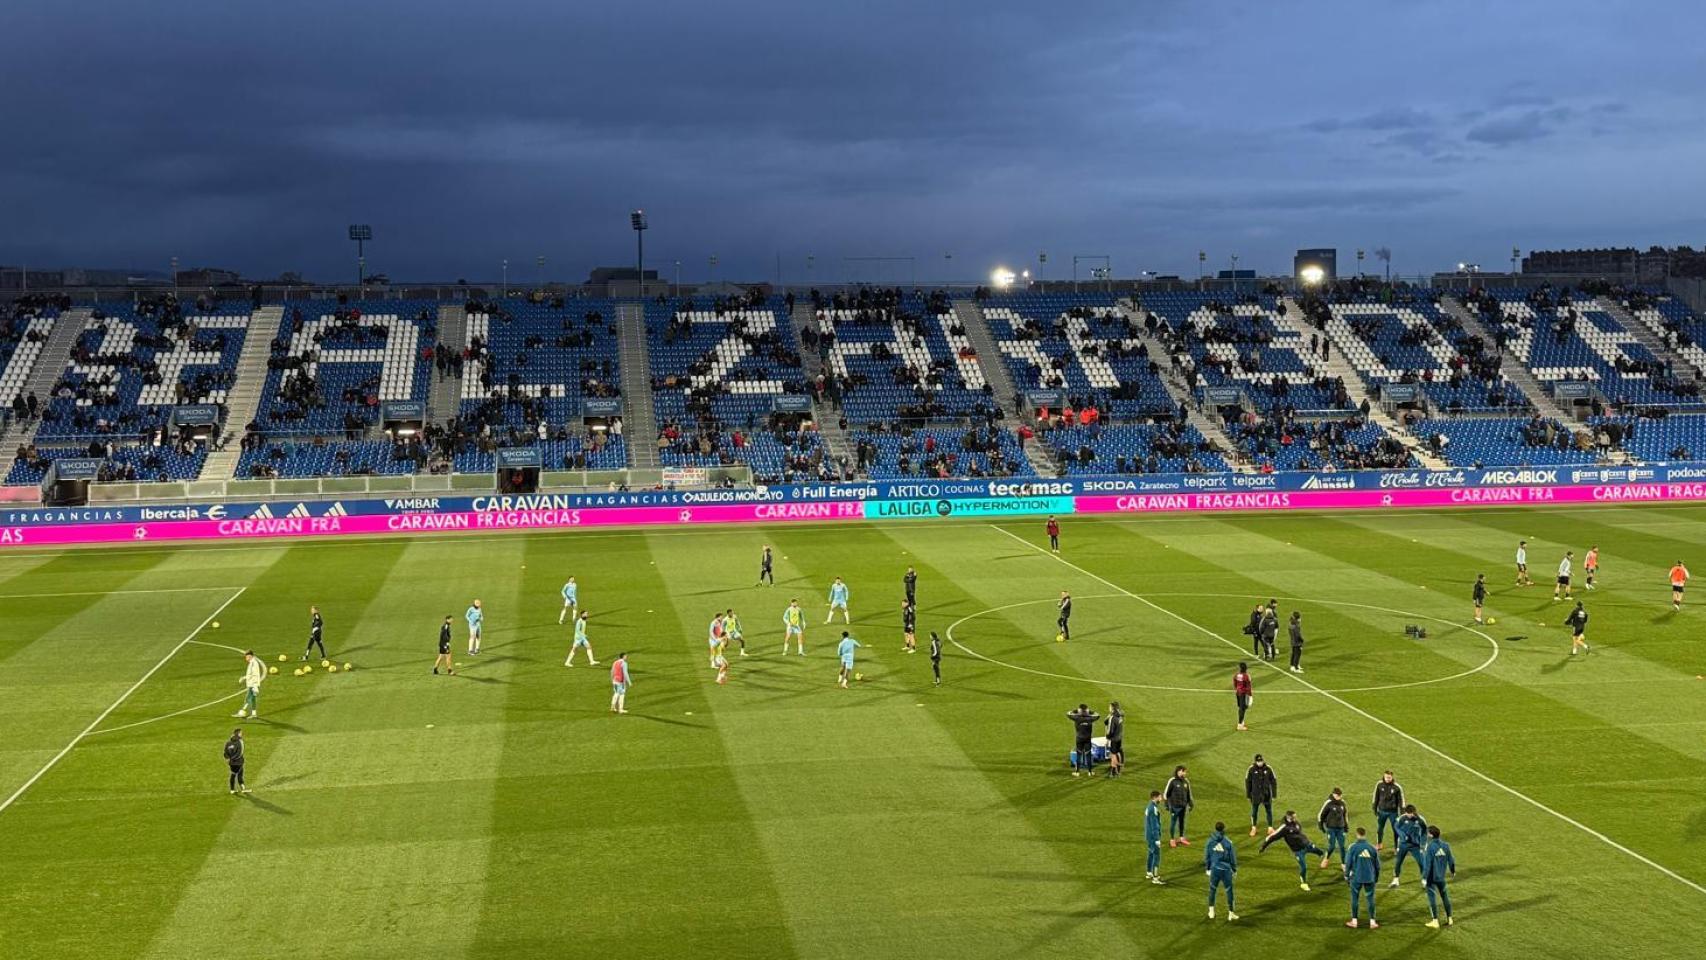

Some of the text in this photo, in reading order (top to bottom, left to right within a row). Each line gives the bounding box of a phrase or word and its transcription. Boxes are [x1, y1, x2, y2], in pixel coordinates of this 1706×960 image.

[1183, 476, 1227, 489] telpark
[1232, 475, 1276, 488] telpark
[1480, 470, 1558, 484] MEGABLOK
[803, 485, 878, 499] Full Energía
[888, 485, 985, 498] ARTICO COCINAS
[1140, 482, 1179, 490] Zaratecno
[1593, 486, 1661, 499] CARAVAN
[693, 492, 734, 502] AZULEJOS
[1116, 493, 1290, 509] CARAVAN FRAGANCIAS
[1451, 487, 1554, 502] CARAVAN FRA
[395, 498, 440, 509] AMBAR
[472, 494, 678, 512] CARAVAN FRAGANCIAS
[755, 501, 864, 518] CARAVAN FRA
[878, 501, 932, 516] LALIGA
[10, 510, 124, 522] FRAGANCIAS
[140, 507, 199, 520] Ibercaja
[388, 511, 580, 529] CARAVAN FRAGANCIAS
[218, 518, 341, 534] CARAVAN FRA
